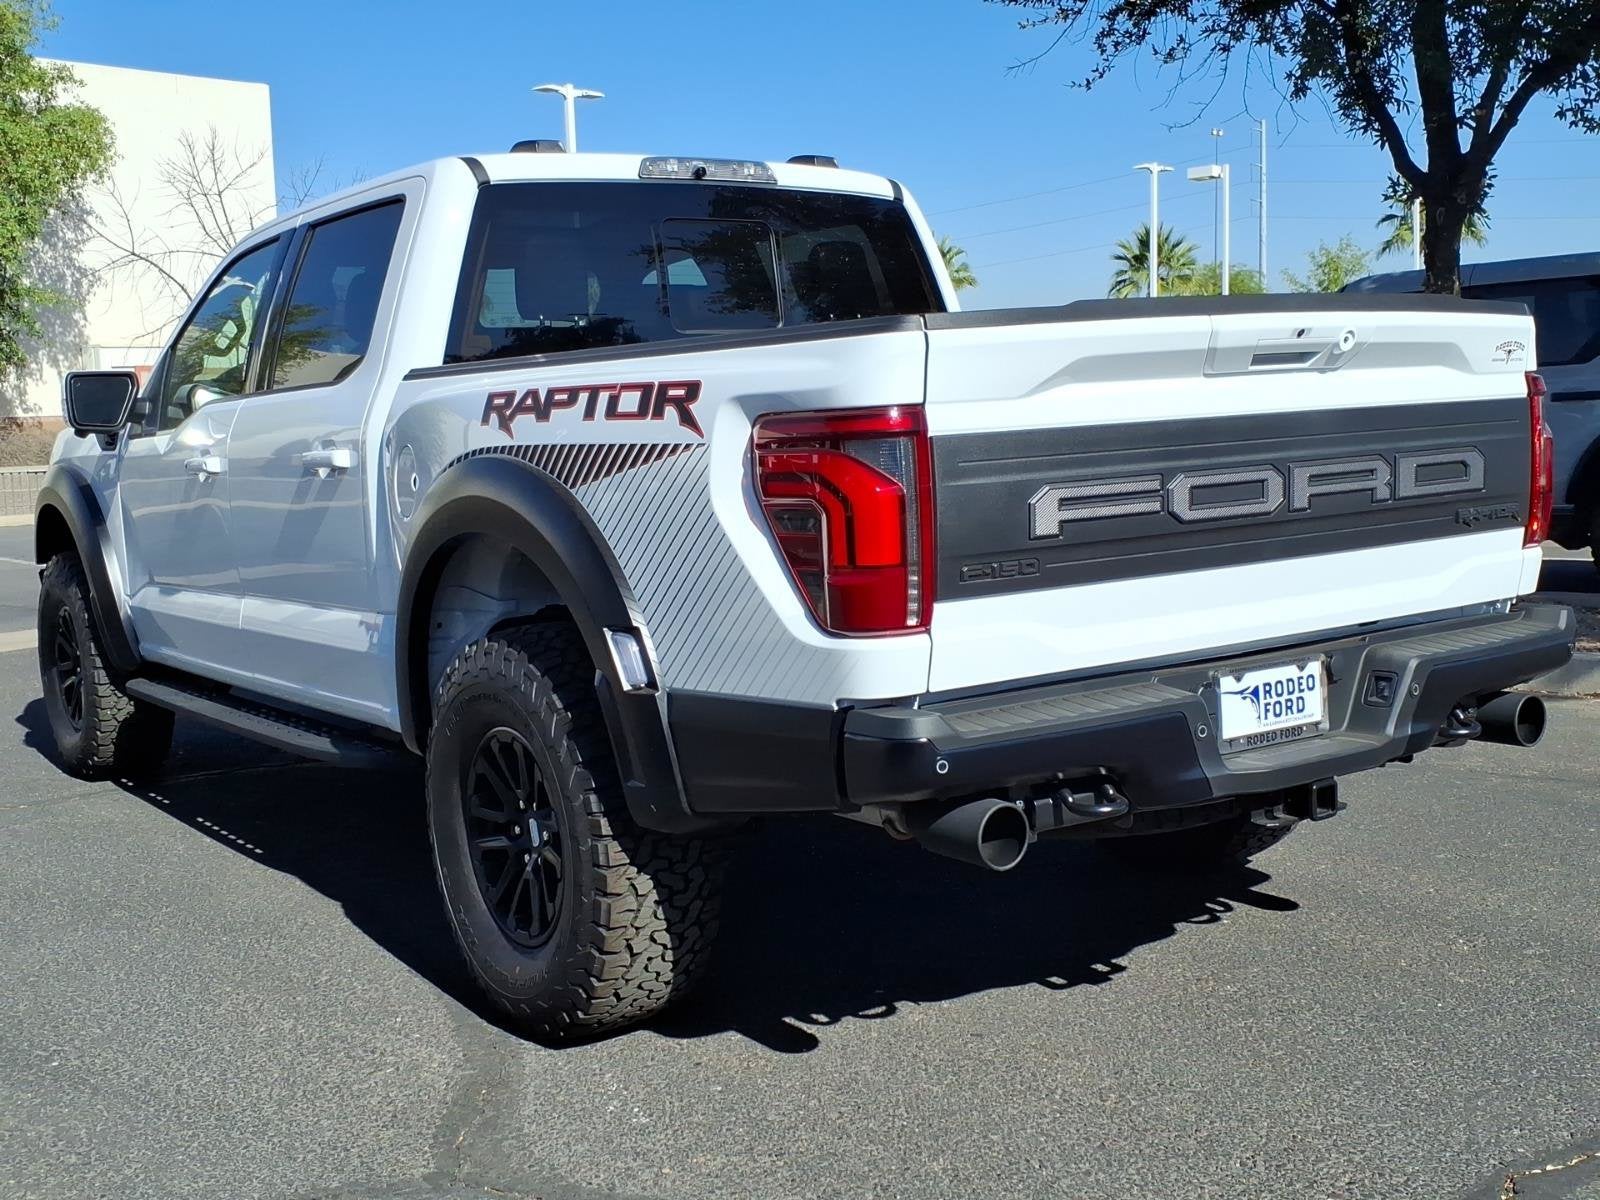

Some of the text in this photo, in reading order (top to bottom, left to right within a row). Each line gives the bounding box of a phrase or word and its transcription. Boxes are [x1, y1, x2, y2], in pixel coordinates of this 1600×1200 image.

[480, 379, 705, 440] RAPTOR
[1027, 445, 1487, 541] FORD
[1262, 673, 1316, 700] RODEO
[1263, 695, 1306, 720] FORD
[1246, 726, 1304, 747] RODEO FORD
